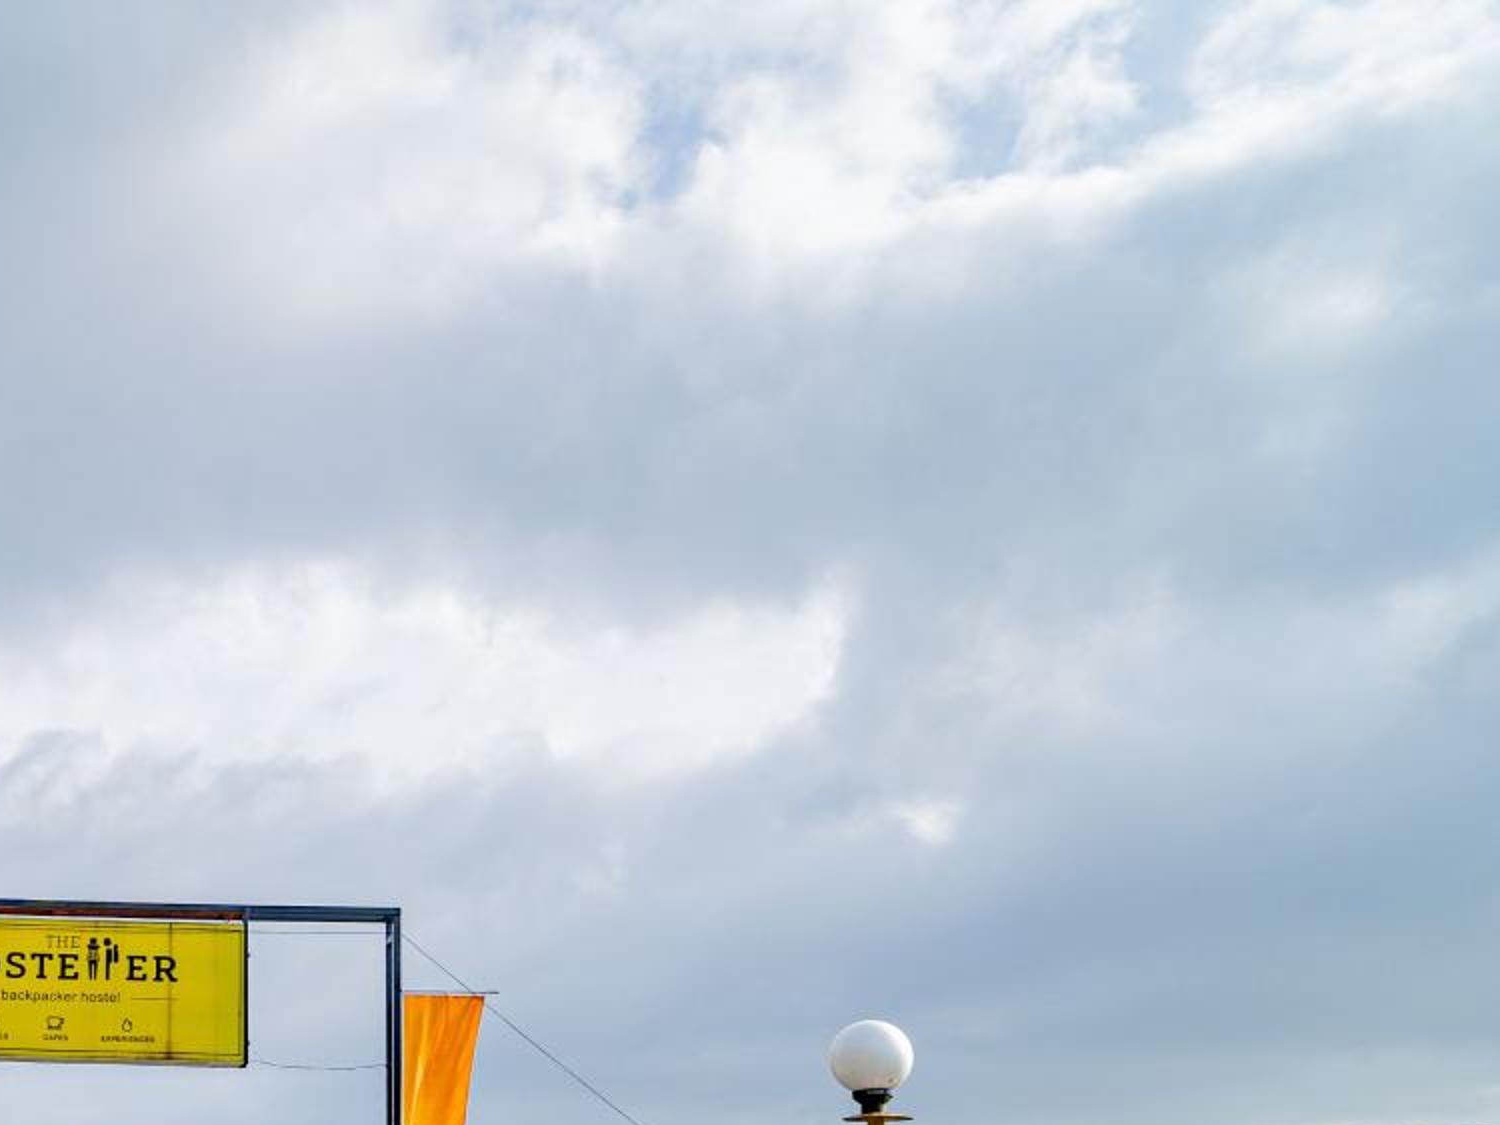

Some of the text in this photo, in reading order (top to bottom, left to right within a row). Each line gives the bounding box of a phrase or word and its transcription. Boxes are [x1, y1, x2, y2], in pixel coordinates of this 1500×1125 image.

[46, 935, 80, 949] THE
[0, 989, 78, 1004] backpacker
[81, 990, 121, 1004] hostel
